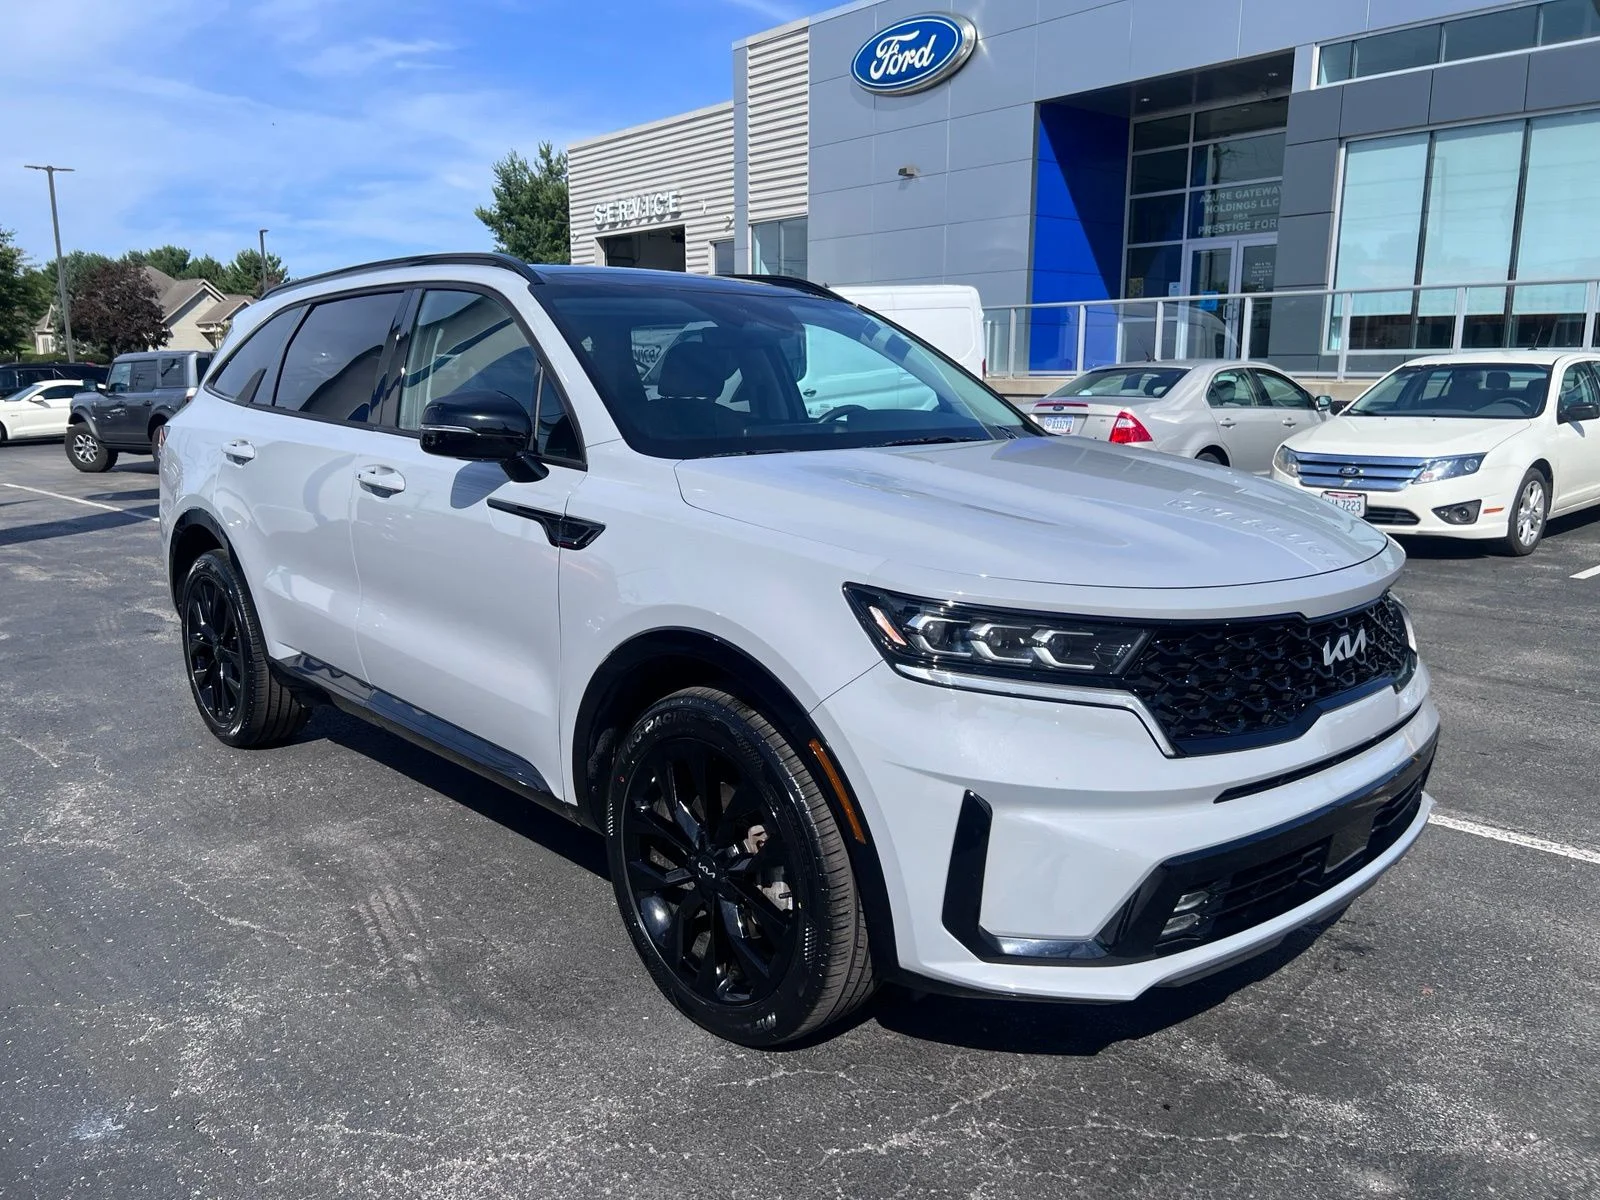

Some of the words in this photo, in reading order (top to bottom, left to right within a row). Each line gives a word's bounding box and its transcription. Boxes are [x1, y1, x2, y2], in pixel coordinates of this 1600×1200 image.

[869, 29, 937, 80] Ford
[1200, 191, 1232, 203] AZURE
[594, 190, 679, 225] SERVICE
[1205, 200, 1257, 214] HOLDINGS
[1260, 198, 1280, 208] LLC
[1198, 221, 1251, 235] PRESTIGE
[1254, 219, 1278, 230] FOR
